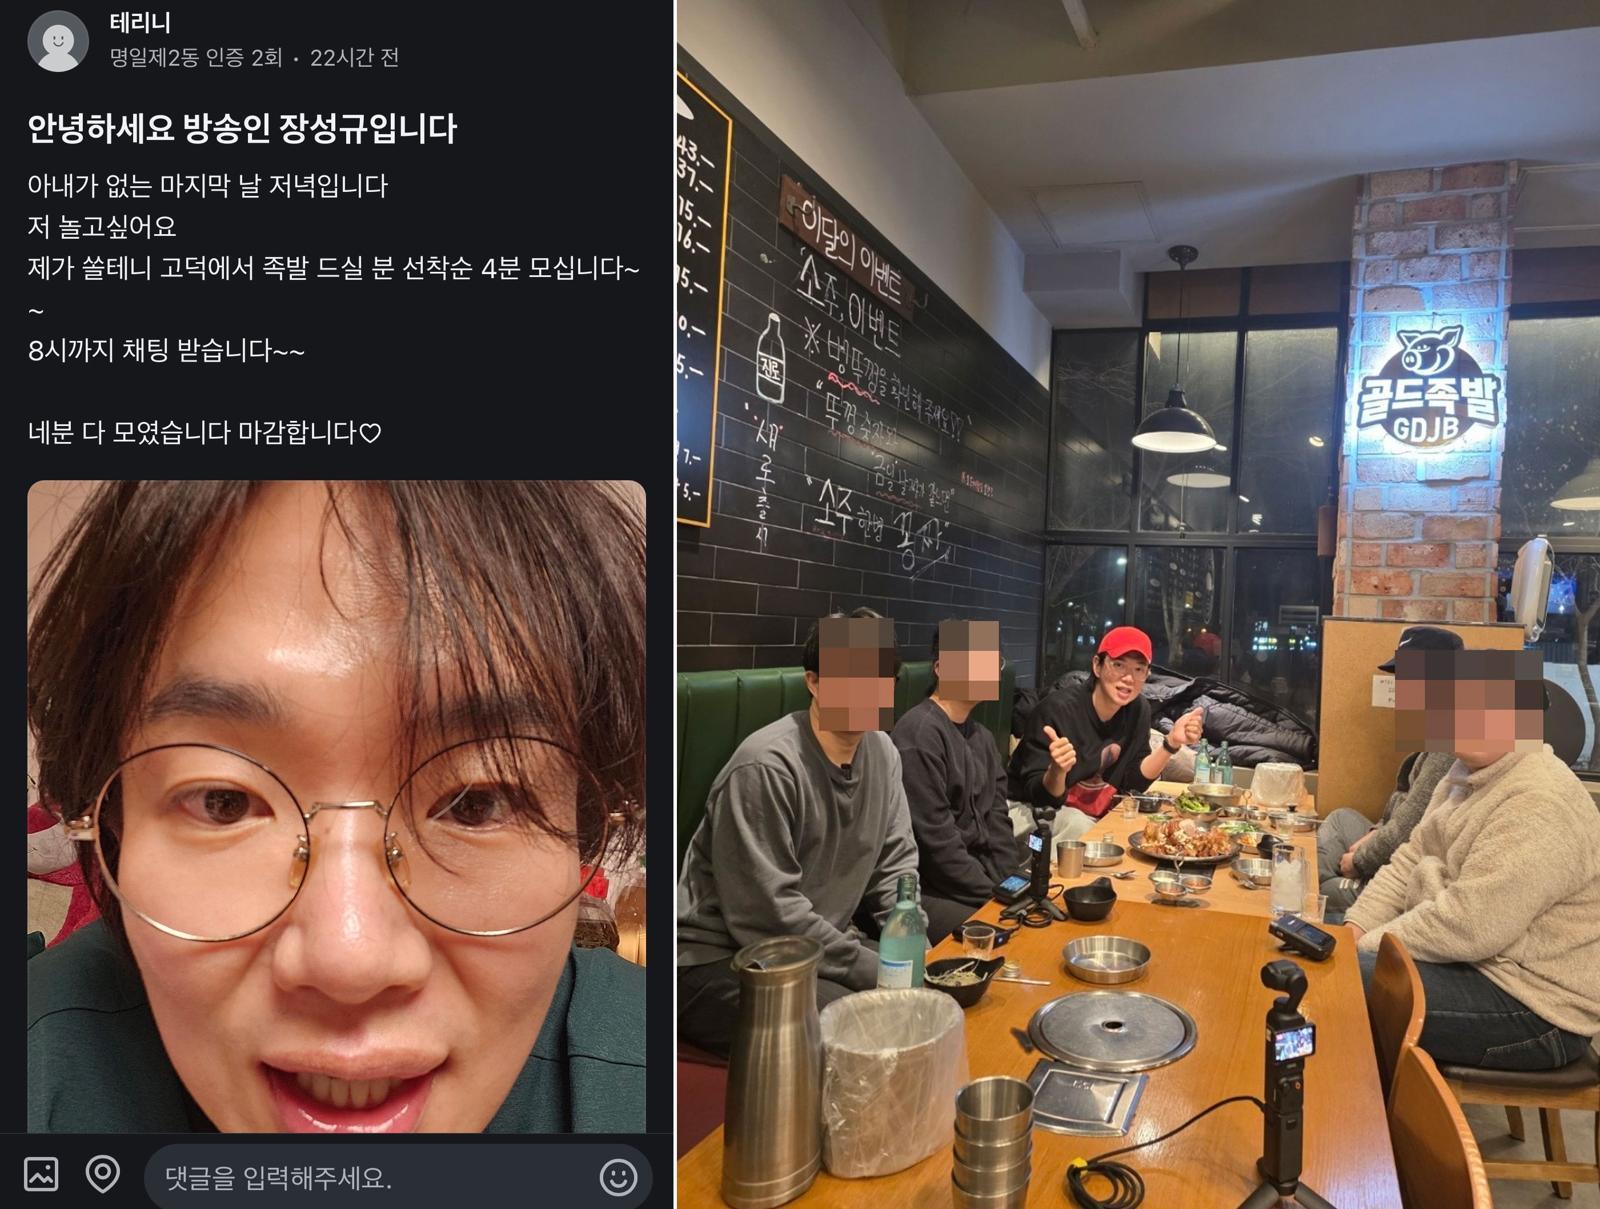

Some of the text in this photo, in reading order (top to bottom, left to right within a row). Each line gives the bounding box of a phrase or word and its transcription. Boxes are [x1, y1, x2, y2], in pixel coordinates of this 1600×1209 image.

[110, 12, 170, 34] 테리니
[111, 48, 398, 68] 명일제2동 인증 2회 22시간 전
[29, 113, 457, 144] 안녕하세요 방송인 장성규입니다
[29, 173, 388, 198] 아내가 없는 마지막 날 저녁입니다
[28, 215, 176, 239] 저 놀고싶어요
[802, 200, 901, 305] 이달의 이벤트
[28, 256, 639, 280] 제가 쏠테니 고덕에서 족발 드실 분 선착순 4분 모십니다~
[849, 293, 900, 357] 이벤트
[29, 338, 304, 363] 8시까지 채팅 받습니다~~
[760, 357, 781, 381] 진로
[828, 330, 888, 397] 병뚜껑을
[1361, 378, 1496, 424] 골드족발
[29, 420, 74, 445] 네분
[83, 420, 105, 445] 다
[113, 420, 231, 445] 모였습니다
[1394, 417, 1459, 443] GDJB
[167, 1166, 391, 1191] 댓글을 입력해주세요.
